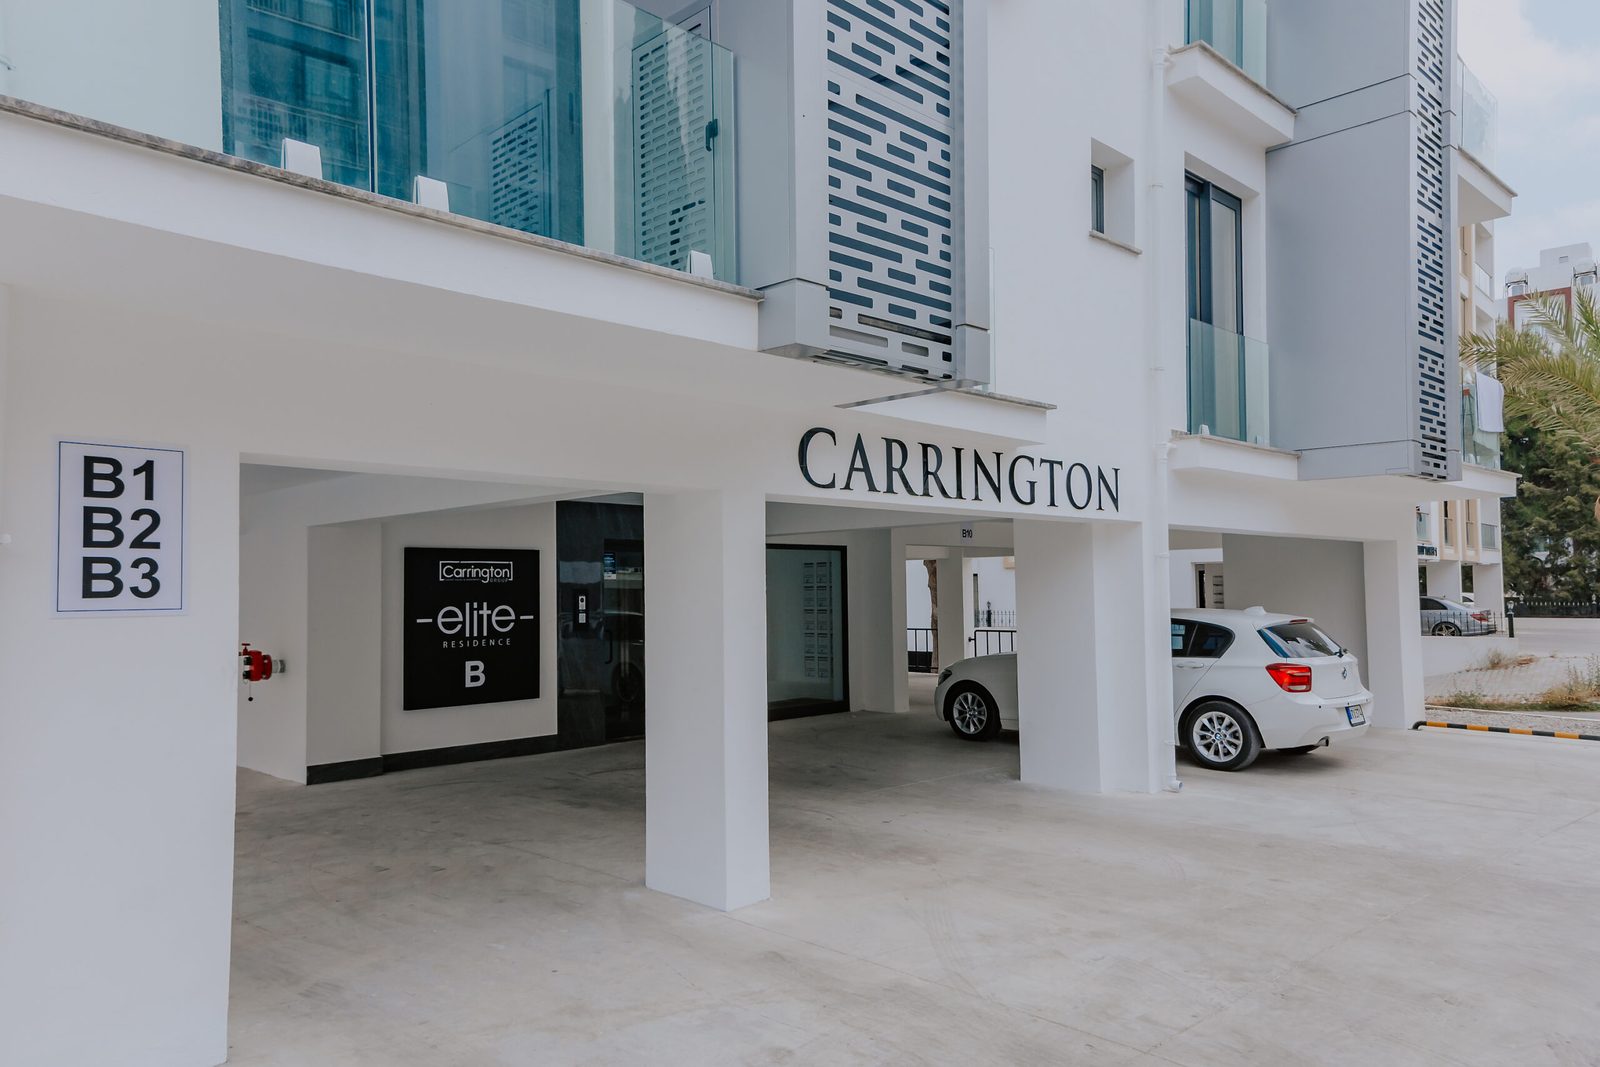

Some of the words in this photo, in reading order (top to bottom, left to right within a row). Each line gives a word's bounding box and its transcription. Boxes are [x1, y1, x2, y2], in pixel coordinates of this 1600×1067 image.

[83, 455, 155, 500] B1
[798, 427, 1120, 513] CARRINGTON
[82, 506, 161, 549] B2
[962, 528, 973, 538] B10
[82, 556, 161, 599] B3
[443, 565, 510, 583] Carrington
[443, 637, 511, 649] RESIDENCE
[465, 660, 486, 688] B
